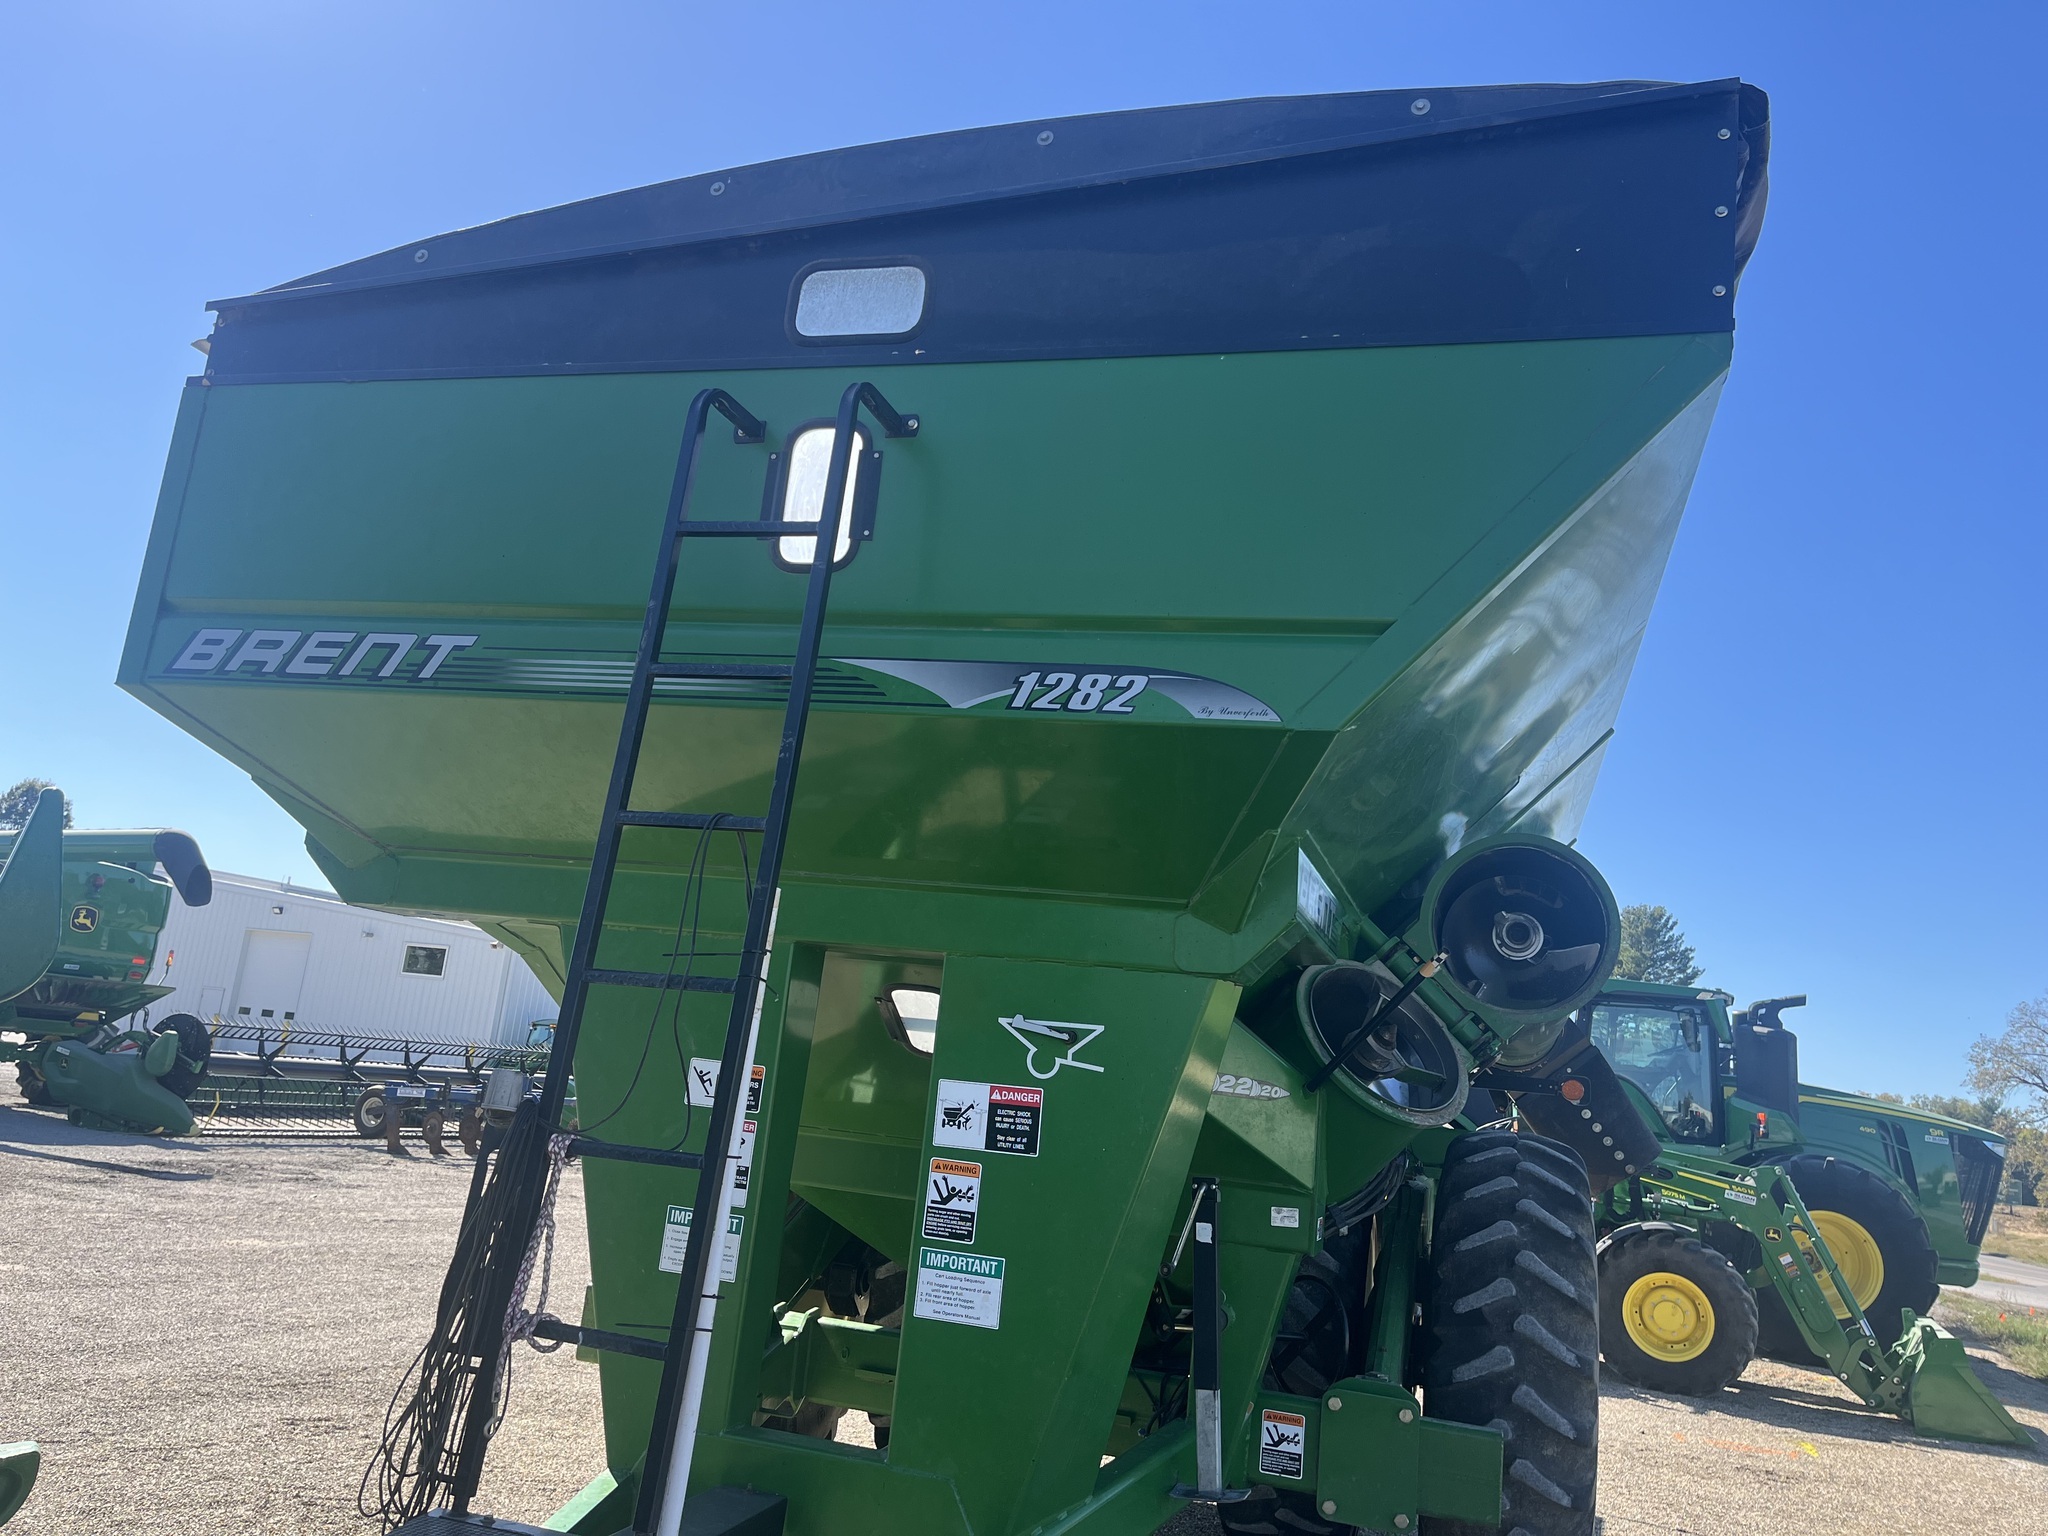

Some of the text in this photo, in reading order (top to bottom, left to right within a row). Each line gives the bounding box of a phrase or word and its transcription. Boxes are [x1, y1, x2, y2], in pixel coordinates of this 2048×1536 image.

[165, 628, 480, 681] BRENT
[1009, 671, 1149, 713] 1282
[1198, 706, 1214, 717] By
[1002, 1091, 1040, 1103] DANGER
[942, 1163, 977, 1174] WARNING
[926, 1252, 998, 1275] IMPORTANT
[1273, 1415, 1301, 1424] WARNING
